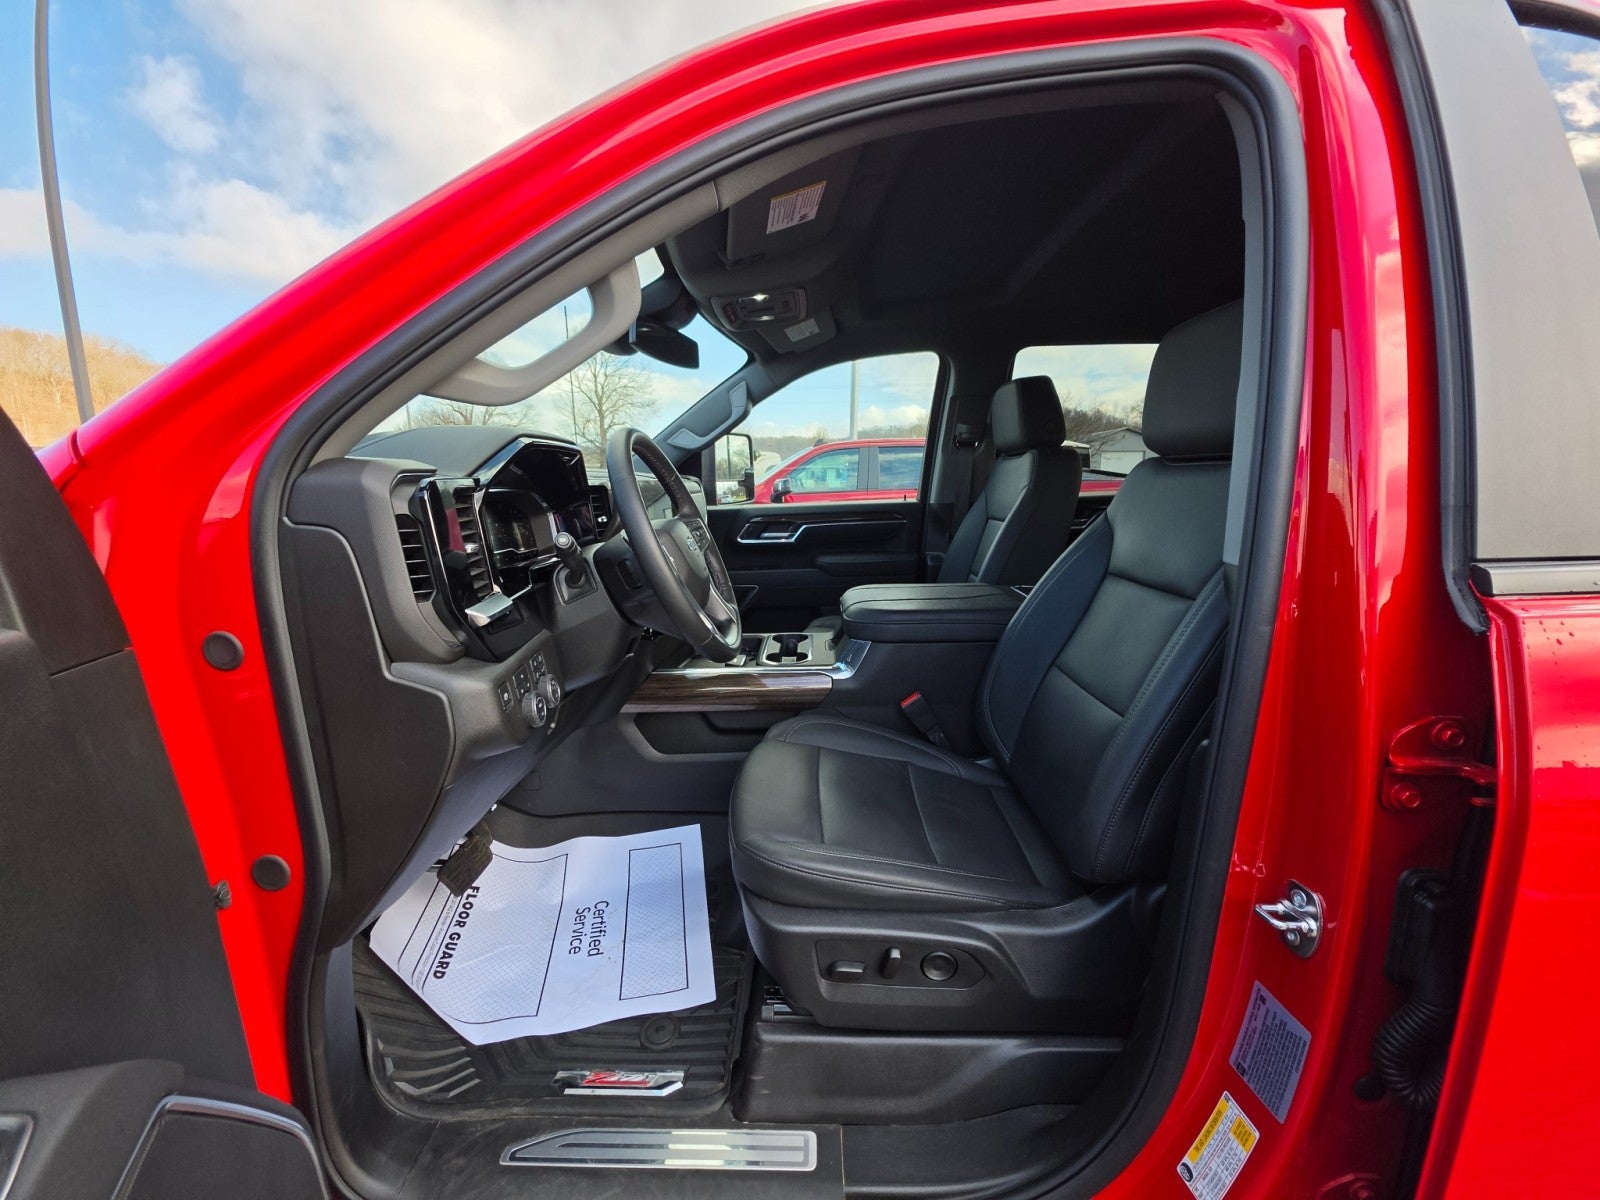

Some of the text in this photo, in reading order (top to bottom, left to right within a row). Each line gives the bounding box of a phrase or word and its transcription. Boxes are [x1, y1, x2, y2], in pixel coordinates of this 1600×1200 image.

[453, 885, 481, 928] FLOOR
[568, 906, 592, 955] Service
[587, 900, 610, 957] Certified
[432, 932, 461, 980] GUARD
